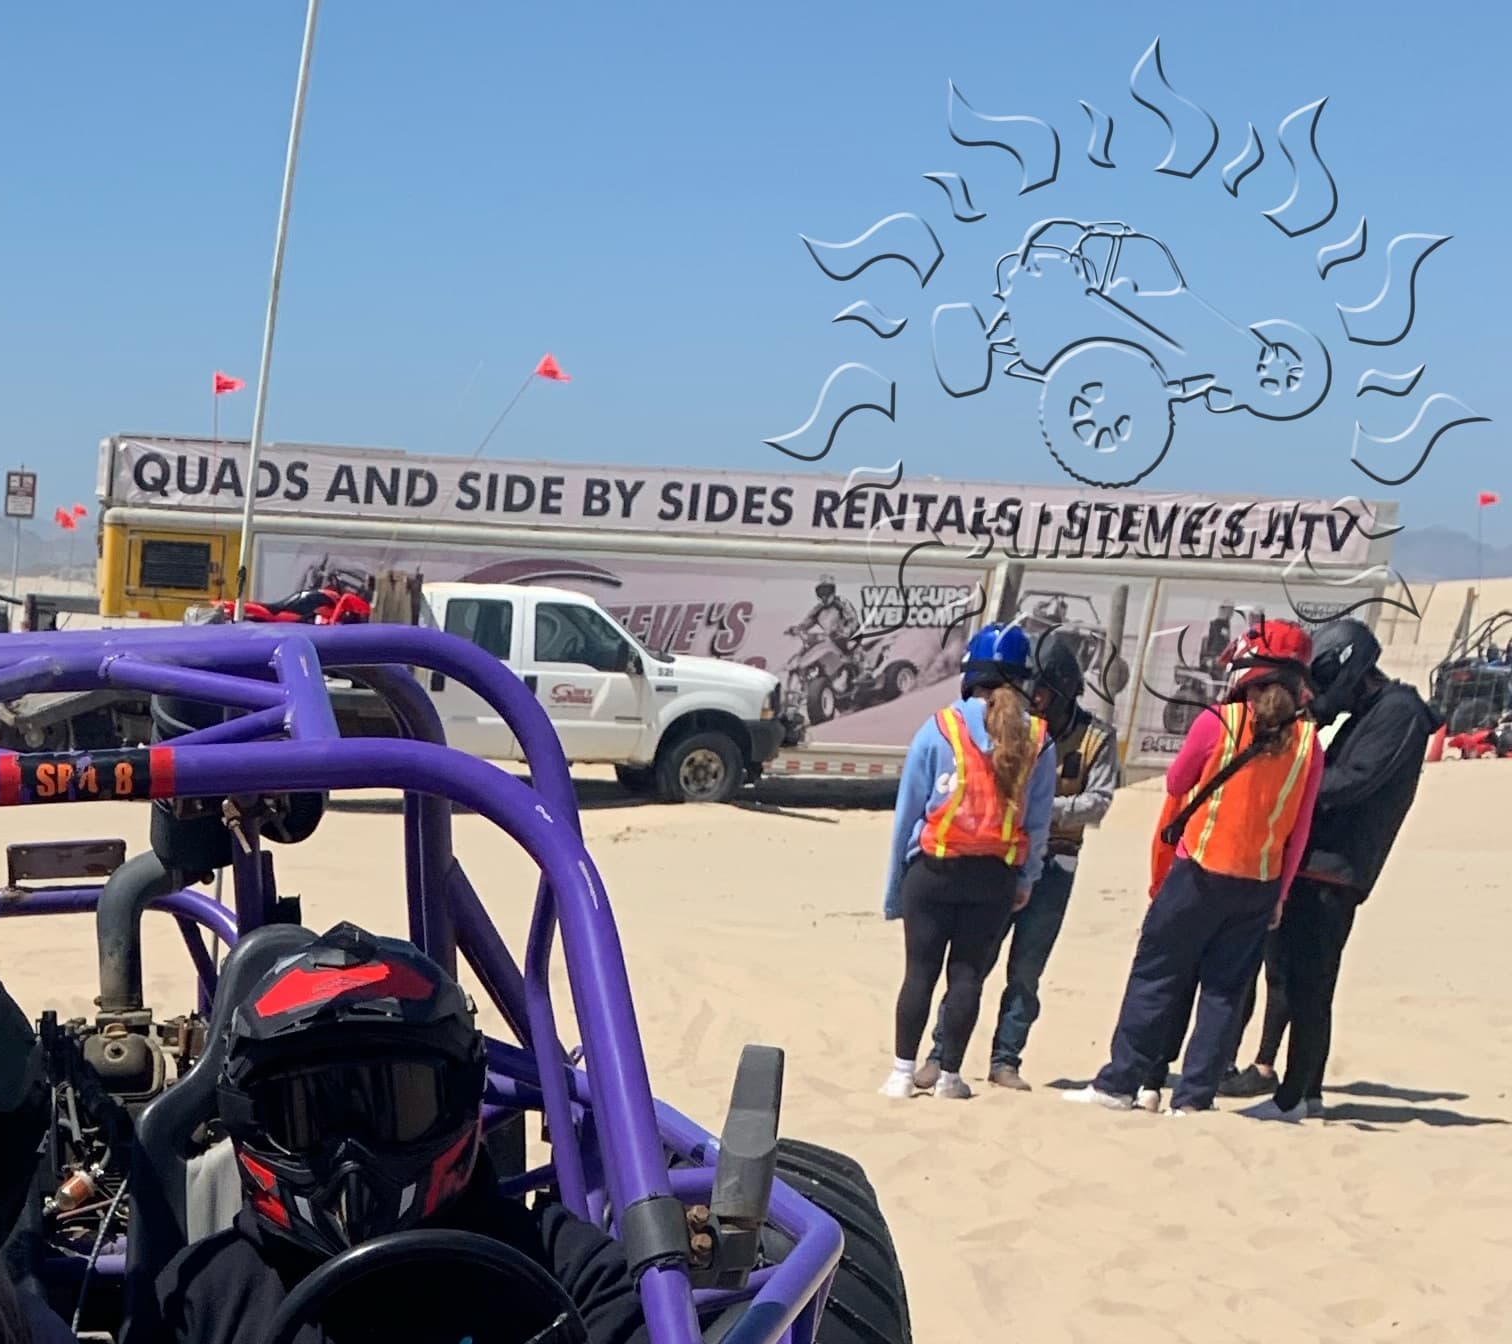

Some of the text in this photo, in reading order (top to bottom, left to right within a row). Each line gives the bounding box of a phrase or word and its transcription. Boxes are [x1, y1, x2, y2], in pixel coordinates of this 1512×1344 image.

[133, 452, 309, 500] QUADS
[324, 464, 438, 507] AND
[455, 471, 565, 515] SIDE
[582, 477, 646, 518] BY
[657, 481, 794, 526] SIDES
[812, 489, 1022, 537] RENTALS
[1260, 509, 1360, 552] ATV
[861, 584, 970, 607] WALK-UPS
[606, 601, 753, 655] TEVE'S
[861, 605, 966, 628] WELCOME
[114, 762, 133, 794] 8
